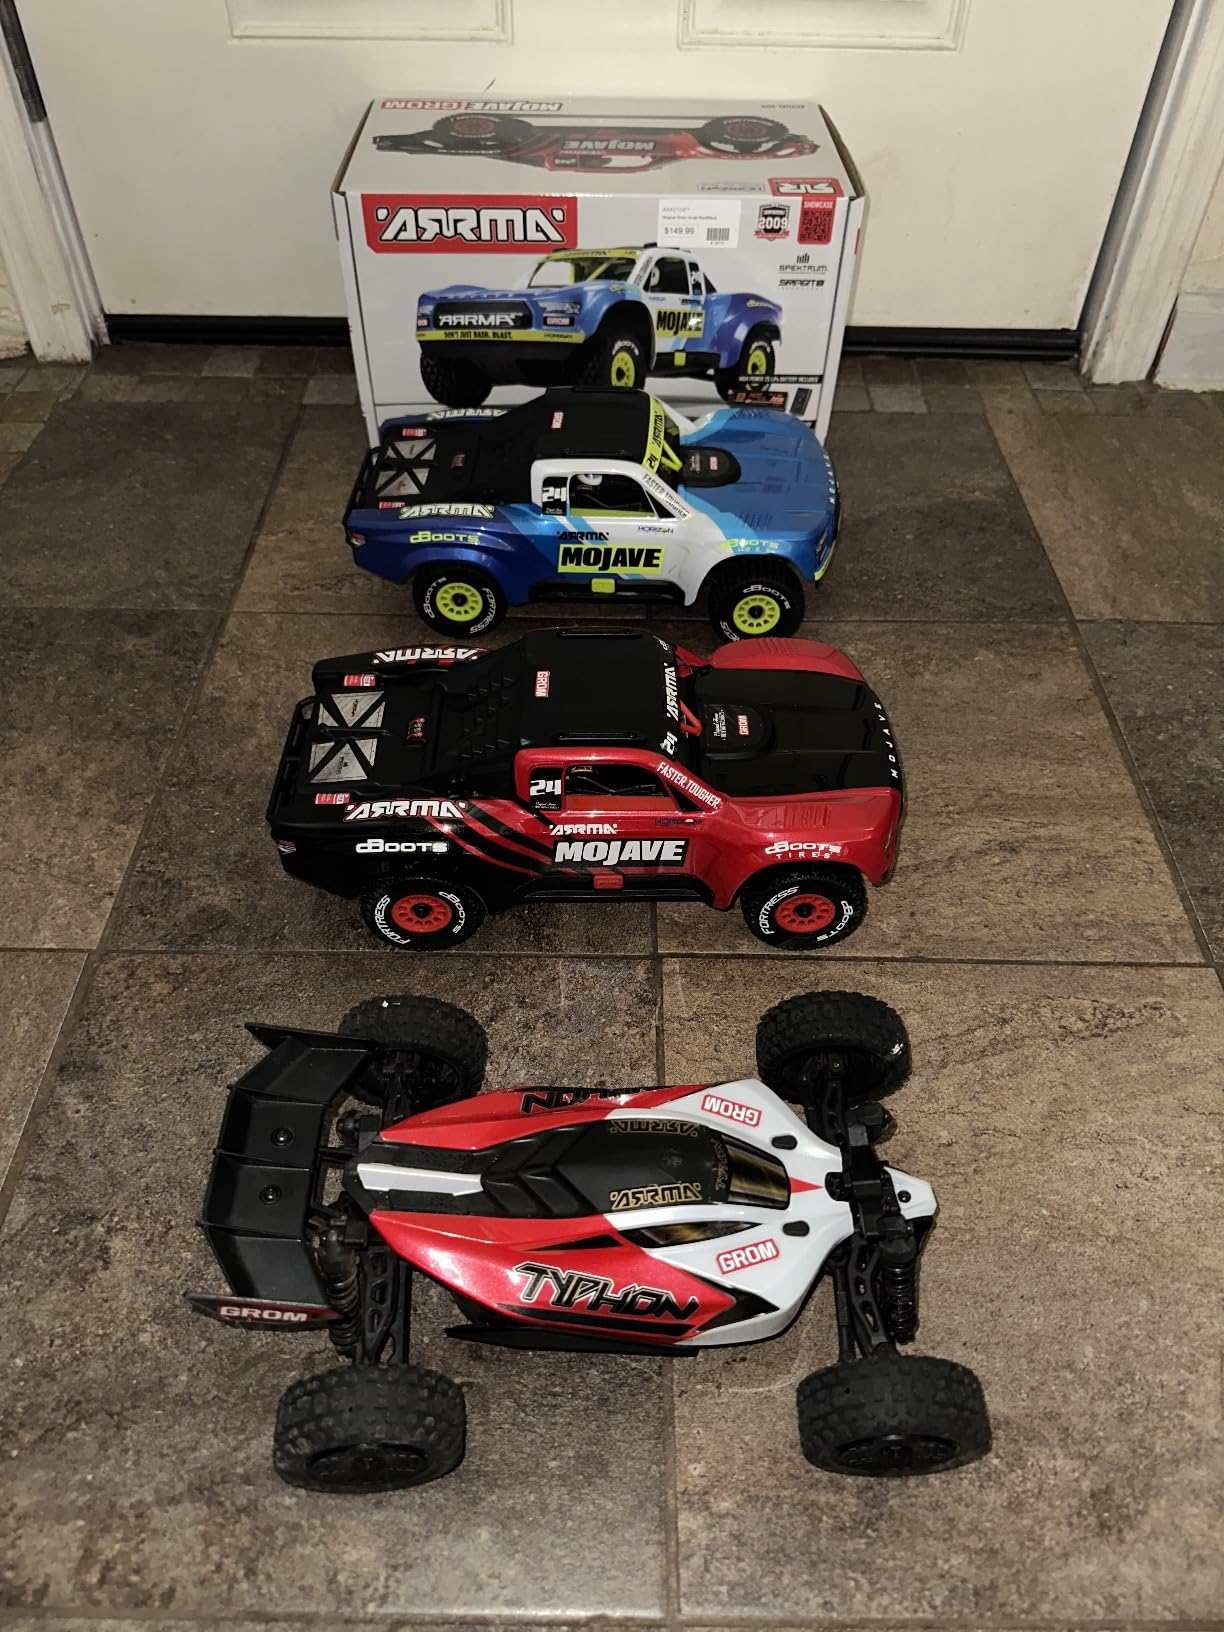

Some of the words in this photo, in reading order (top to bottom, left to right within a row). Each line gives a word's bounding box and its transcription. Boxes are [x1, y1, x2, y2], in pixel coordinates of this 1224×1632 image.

[382, 100, 463, 110] GROM
[465, 101, 563, 112] MOJAVE
[562, 140, 655, 150] MOJAVE
[803, 201, 833, 209] SHOWCASE
[376, 207, 566, 242] ARRMA
[664, 226, 695, 235] $149.99
[758, 217, 788, 230] 2009
[542, 486, 567, 502] 24
[561, 546, 662, 571] MOJAVE
[469, 588, 497, 634] FORTRESS
[535, 670, 549, 698] GROM
[737, 715, 750, 736] GROM
[660, 731, 678, 756] 24
[874, 702, 899, 779] MOJAVE
[529, 779, 562, 796] 24
[346, 800, 466, 821] ARRMA
[555, 840, 686, 866] MOJAVE
[374, 894, 411, 945] FORTRESS
[759, 886, 800, 935] FORTRESS
[703, 1096, 759, 1126] GROM
[610, 1182, 702, 1211] ARRMA
[718, 1241, 778, 1273] GROM
[513, 1261, 701, 1321] TYPHON
[219, 1306, 309, 1322] GROM
